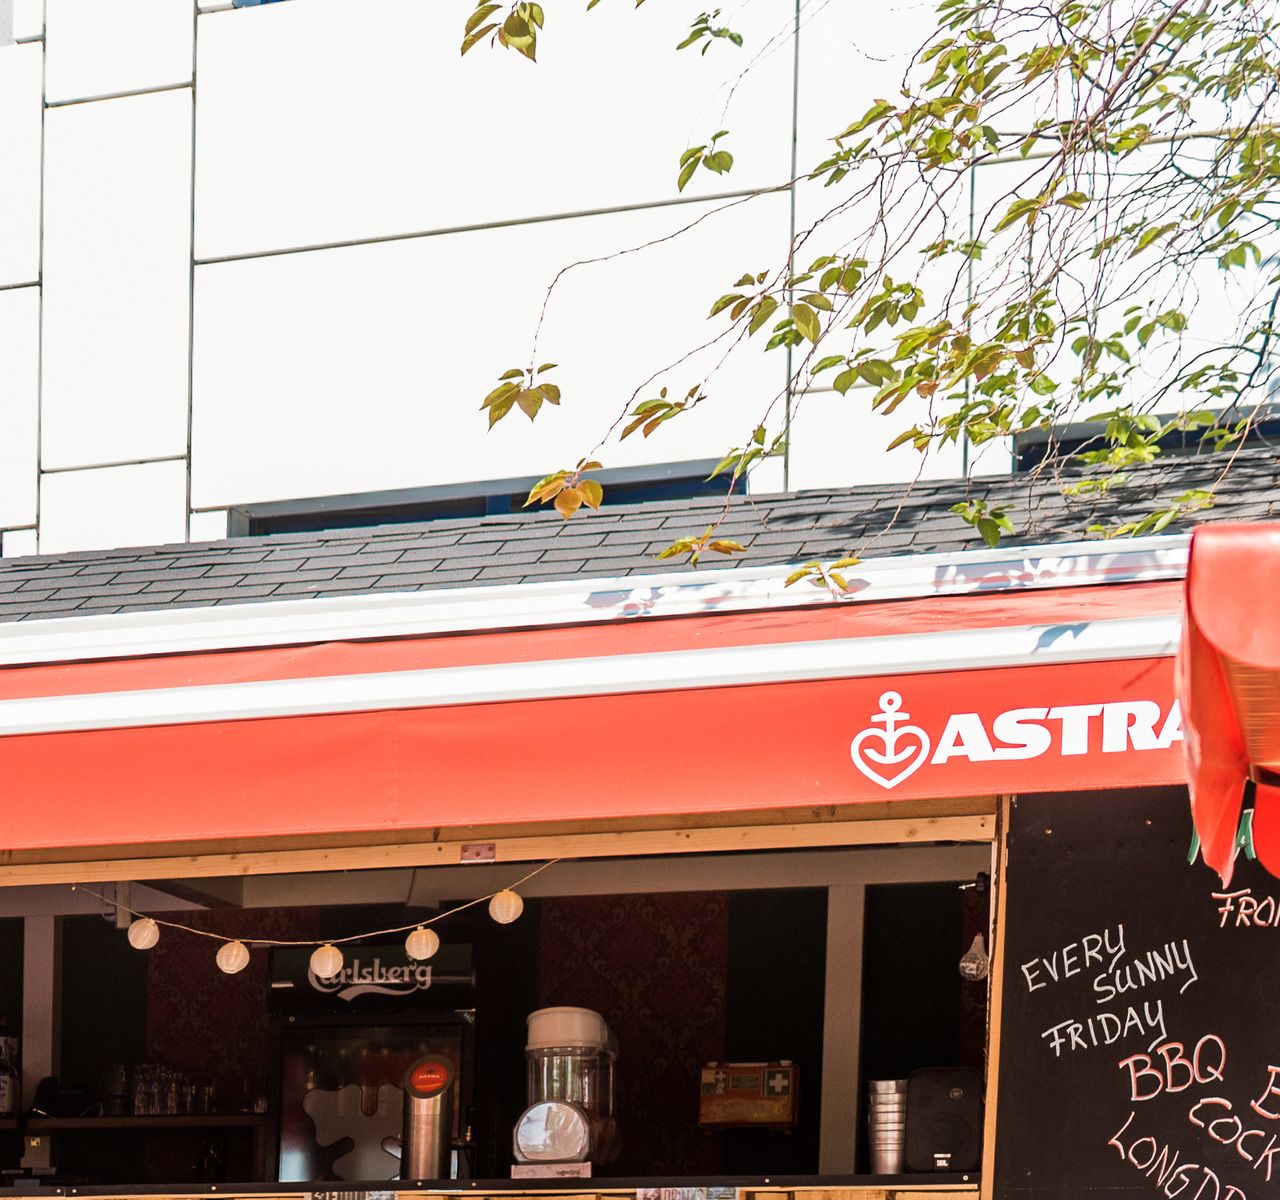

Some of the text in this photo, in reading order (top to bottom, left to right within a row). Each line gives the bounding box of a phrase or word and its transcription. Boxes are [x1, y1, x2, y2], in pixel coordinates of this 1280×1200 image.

[930, 698, 1186, 765] ASTR
[1211, 888, 1280, 928] FRO
[1021, 924, 1126, 993] EVERY
[1093, 939, 1199, 1004] SUNNY
[1041, 1000, 1168, 1057] FRIDAY
[1119, 1034, 1226, 1101] BBQ
